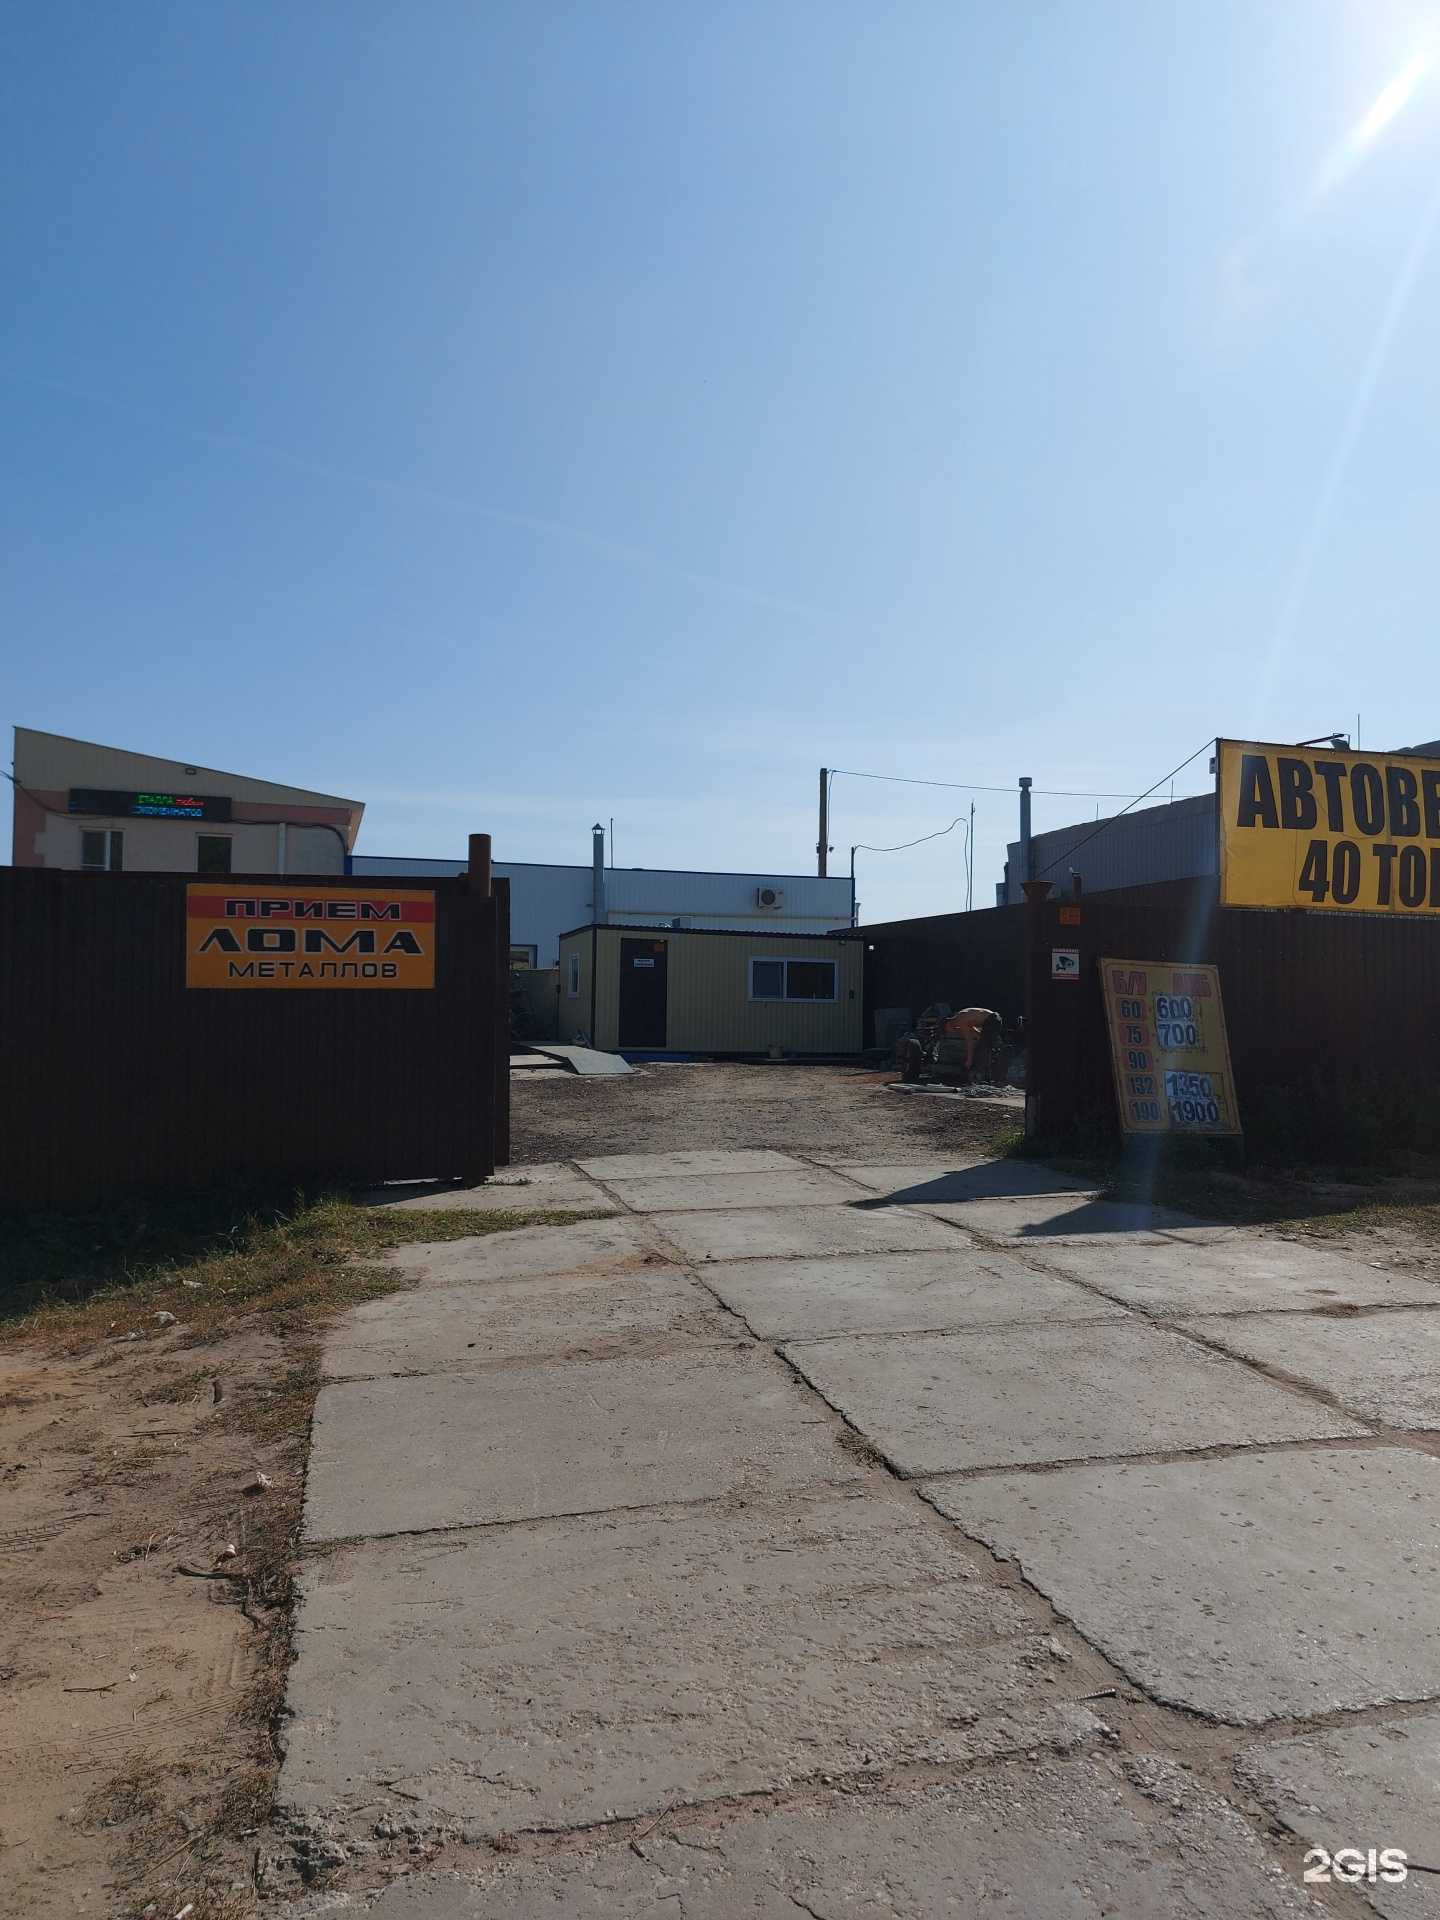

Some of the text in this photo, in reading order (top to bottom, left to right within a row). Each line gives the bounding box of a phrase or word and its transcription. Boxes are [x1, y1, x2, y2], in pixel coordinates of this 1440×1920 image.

[1299, 839, 1361, 905] 40
[225, 899, 401, 920] ПРИЕМ
[199, 927, 423, 955] ЛОМА
[228, 961, 398, 979] МЕТАЛЛОВ
[1120, 996, 1193, 1021] 60 600
[1157, 1022, 1198, 1047] 700
[1128, 1051, 1147, 1070] 90
[1173, 1099, 1220, 1123] 1900
